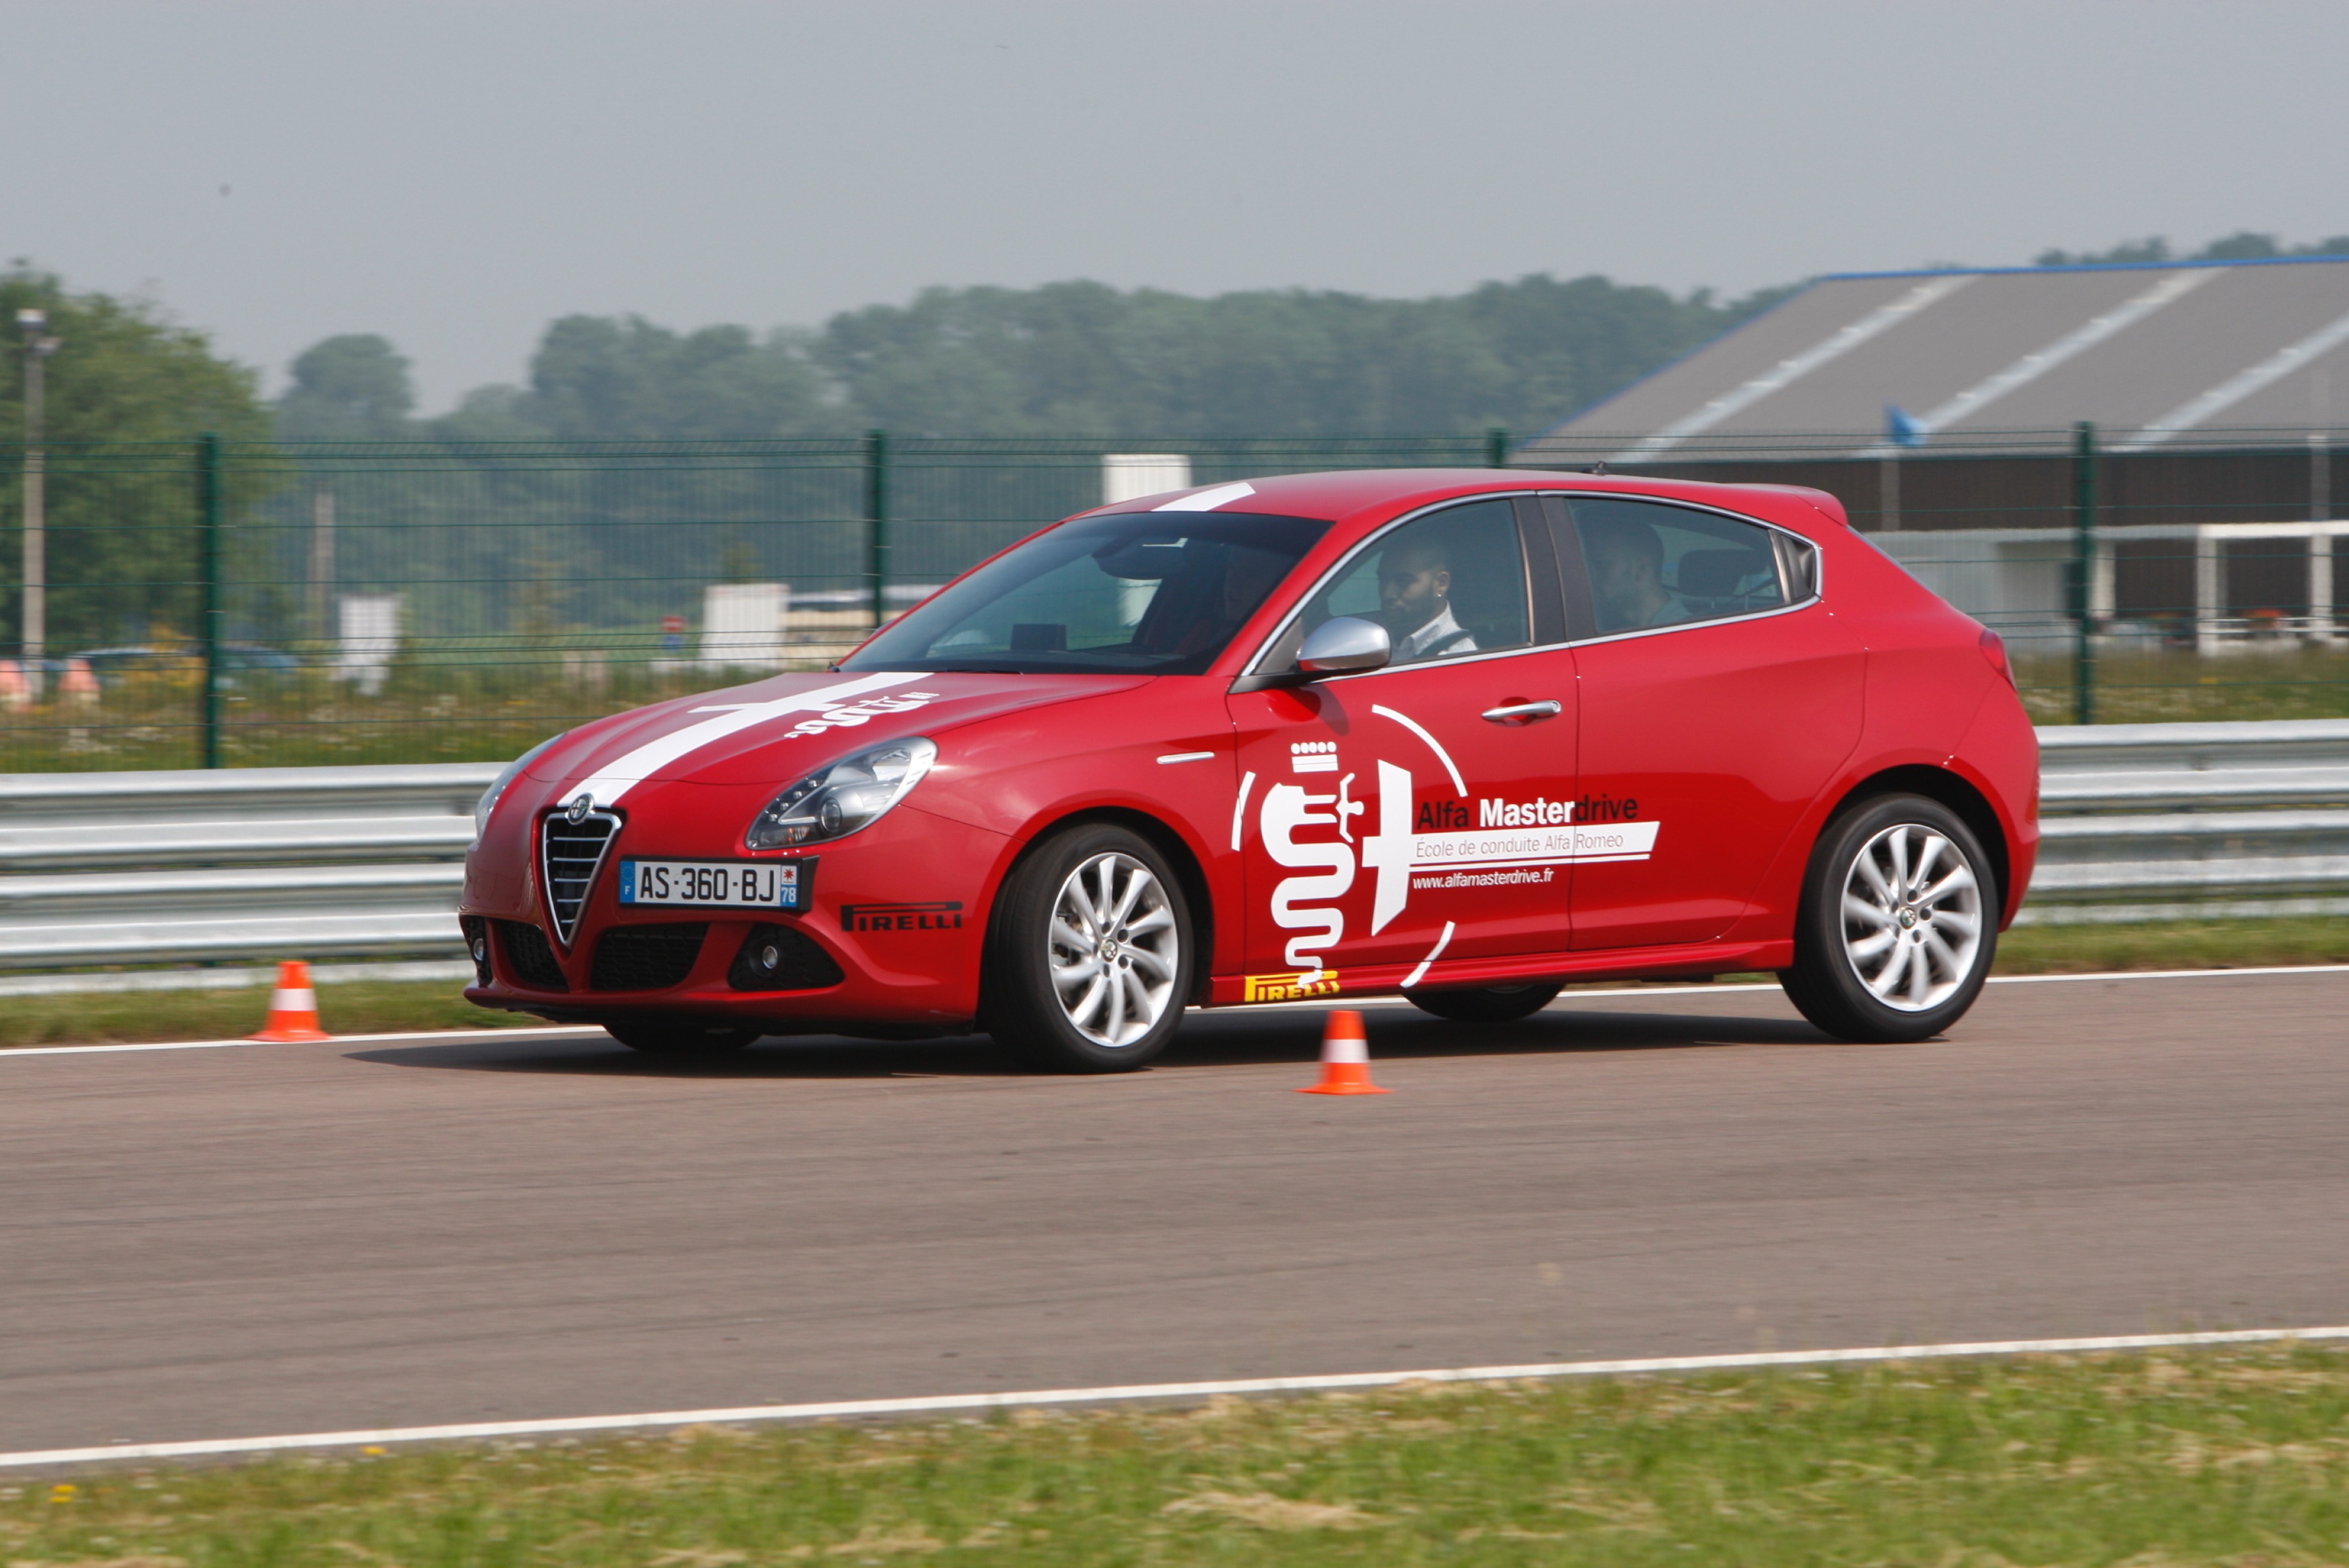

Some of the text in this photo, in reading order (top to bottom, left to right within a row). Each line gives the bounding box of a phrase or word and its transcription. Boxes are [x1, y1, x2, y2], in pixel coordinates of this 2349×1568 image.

[1417, 794, 1638, 829] Alfa Masterdrive
[1416, 833, 1624, 858] École de conduite Alfa Romeo
[625, 885, 631, 895] F
[1413, 867, 1555, 890] www.alfamasterdrive.fr
[780, 886, 796, 904] 78
[840, 900, 964, 932] PIRELLI
[1244, 970, 1341, 1002] PIRELLI
